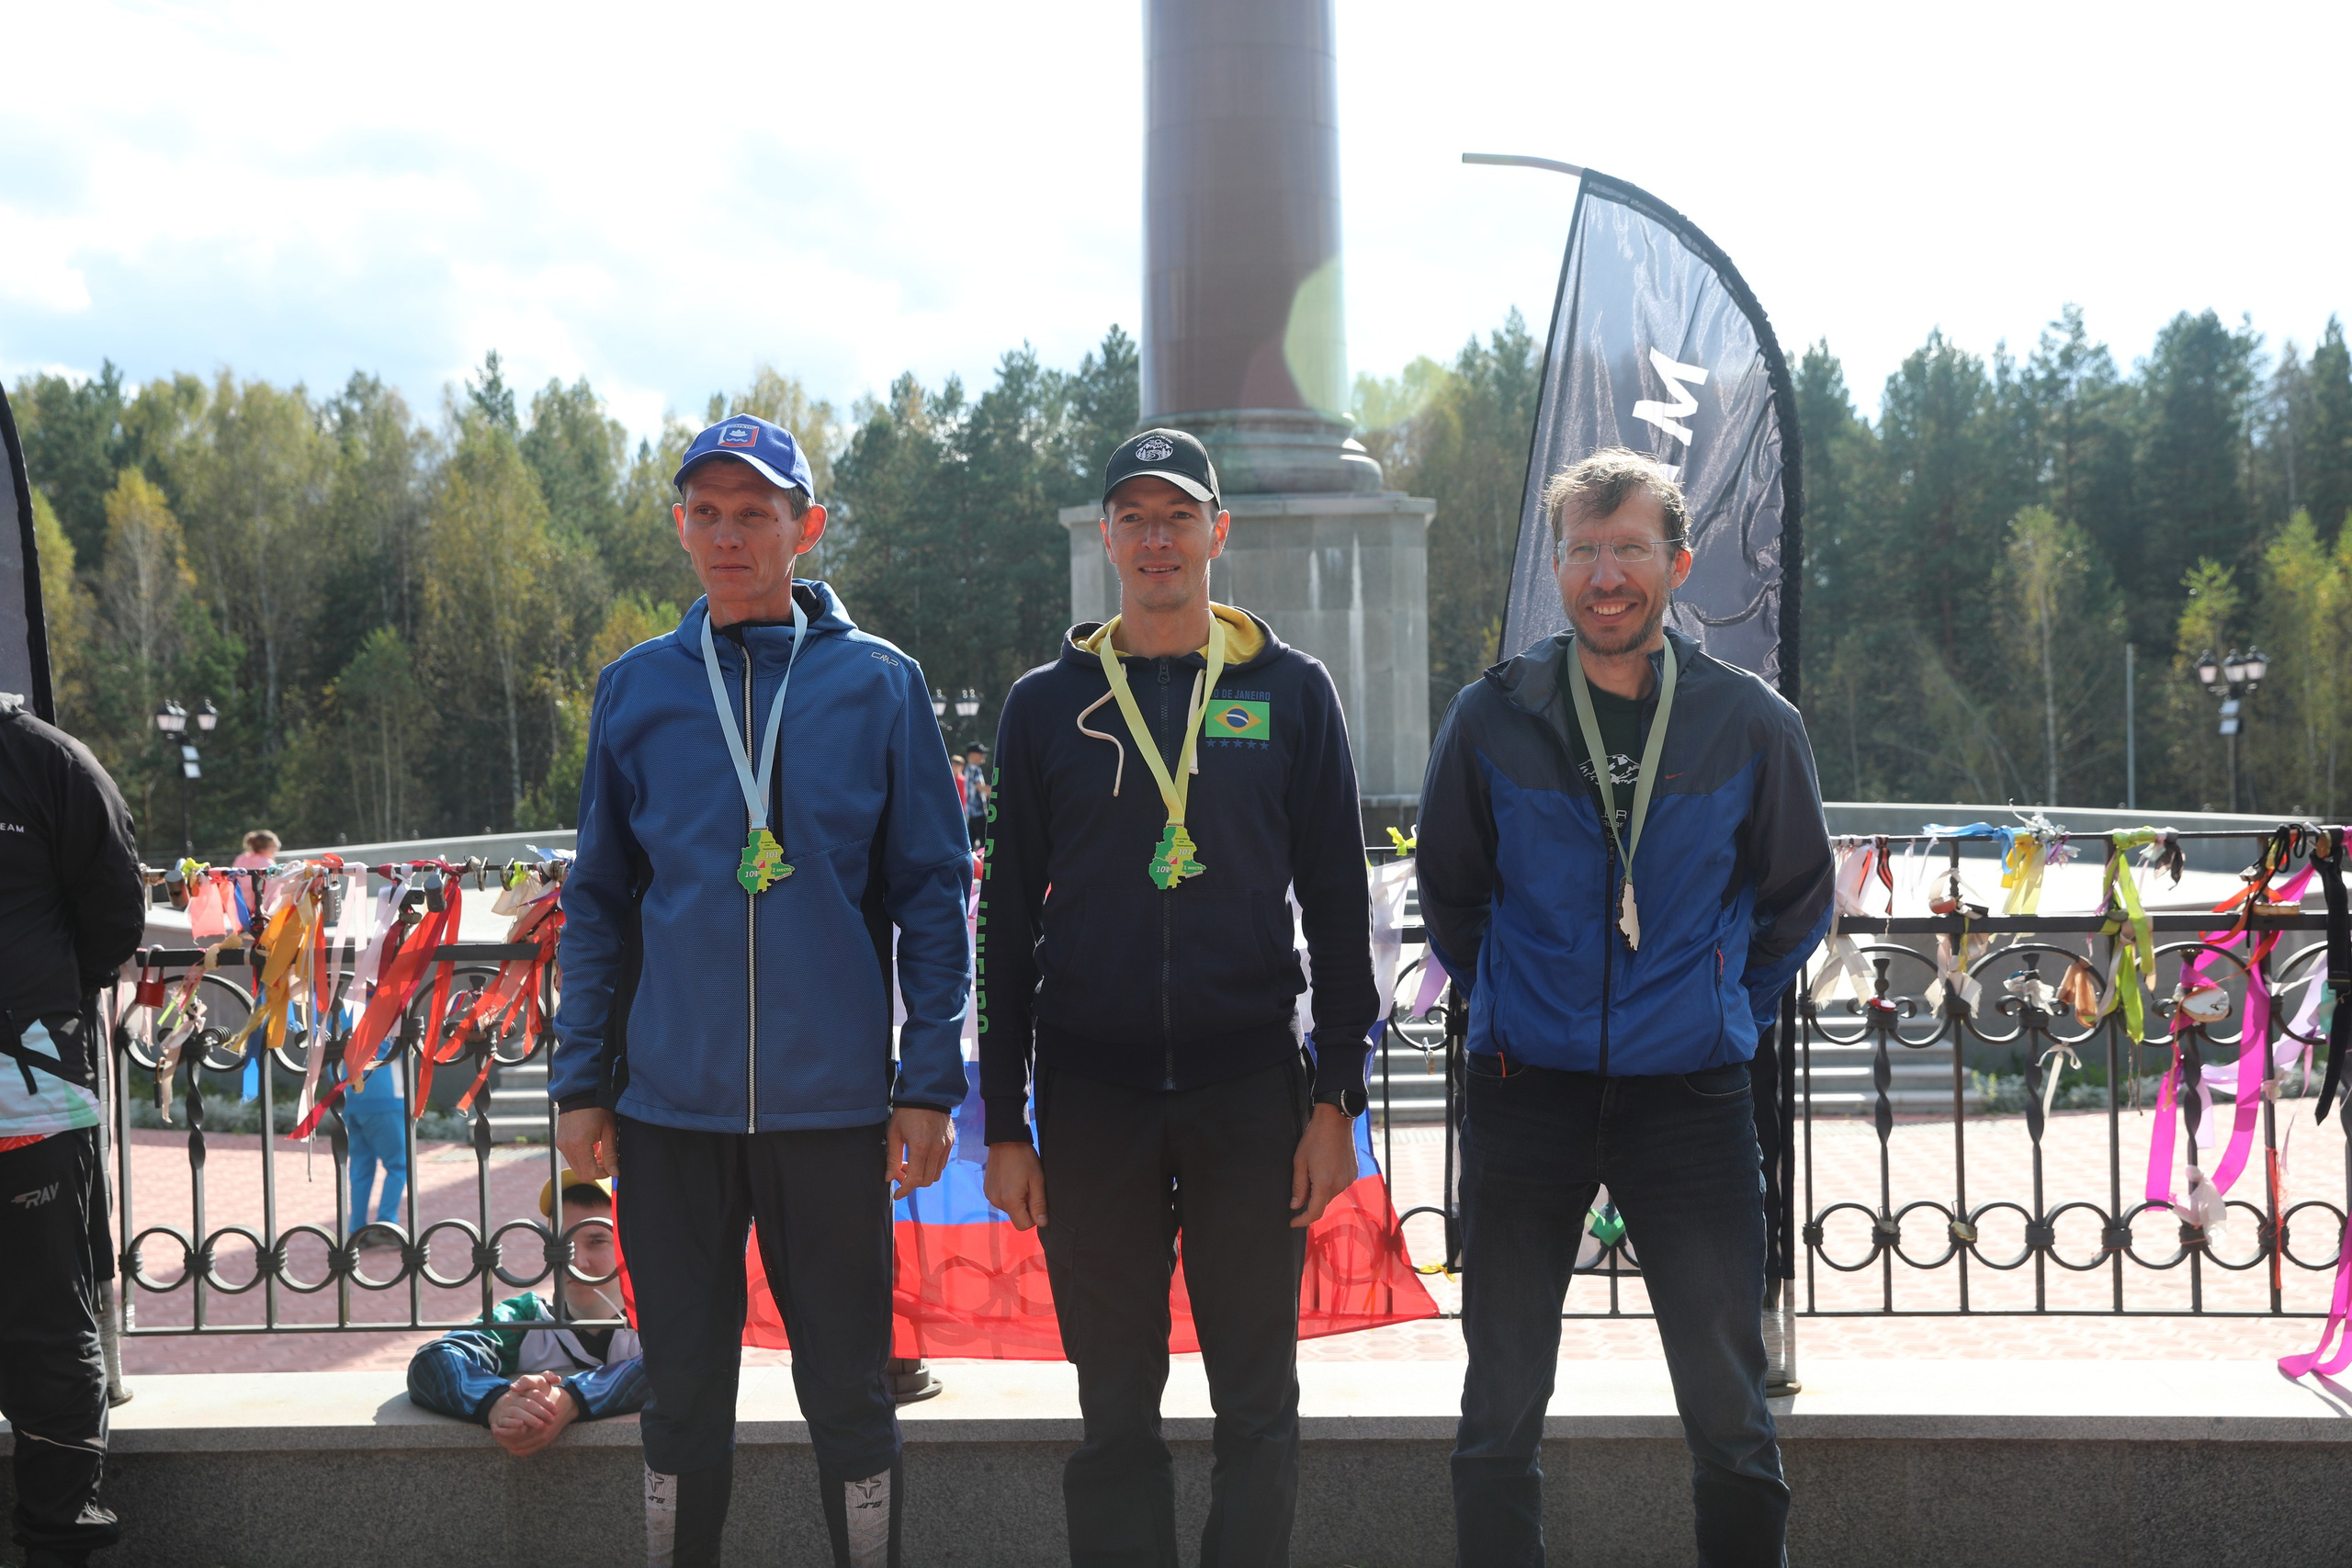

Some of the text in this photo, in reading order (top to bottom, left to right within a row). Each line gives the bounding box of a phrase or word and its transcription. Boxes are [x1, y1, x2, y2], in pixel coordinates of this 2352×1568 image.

[1222, 689, 1233, 699] DE
[1235, 690, 1271, 701] JANEIRO
[745, 870, 758, 878] 101
